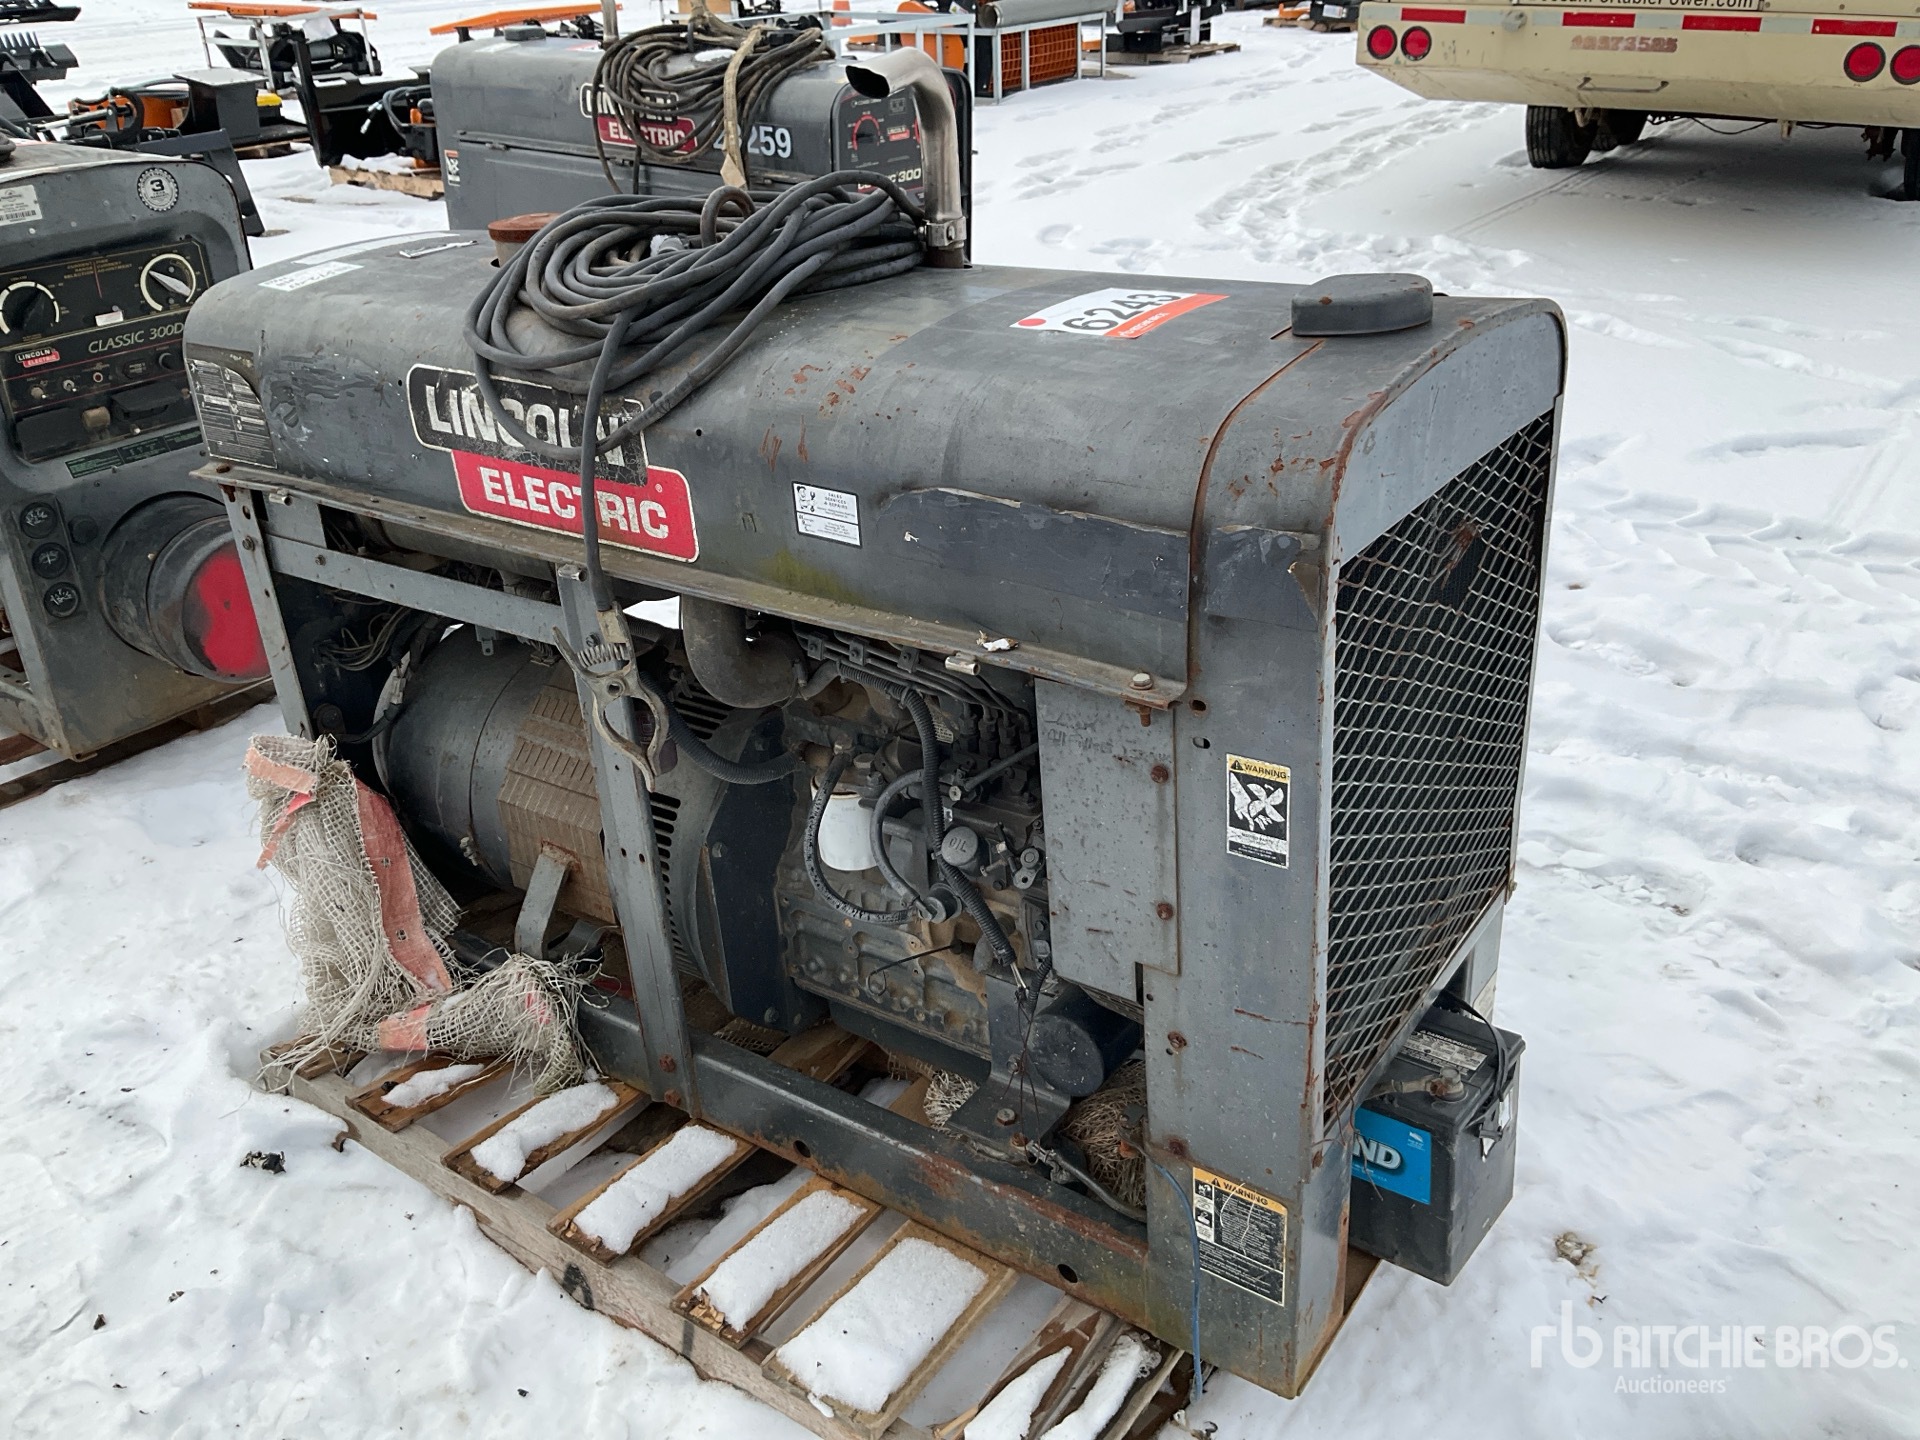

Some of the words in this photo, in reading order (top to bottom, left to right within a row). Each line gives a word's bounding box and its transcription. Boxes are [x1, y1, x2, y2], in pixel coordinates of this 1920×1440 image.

[608, 121, 686, 148] ELTRIC
[150, 179, 165, 192] 3
[1062, 293, 1181, 330] 6243
[88, 331, 145, 354] CLASSIC
[149, 322, 184, 341] 300D
[17, 349, 50, 361] LINCOLN
[28, 355, 56, 366] ELECTRIC
[1244, 763, 1286, 779] WARNING
[949, 836, 967, 853] OIL
[1352, 1133, 1401, 1170] ND
[1223, 1182, 1269, 1206] WARNING
